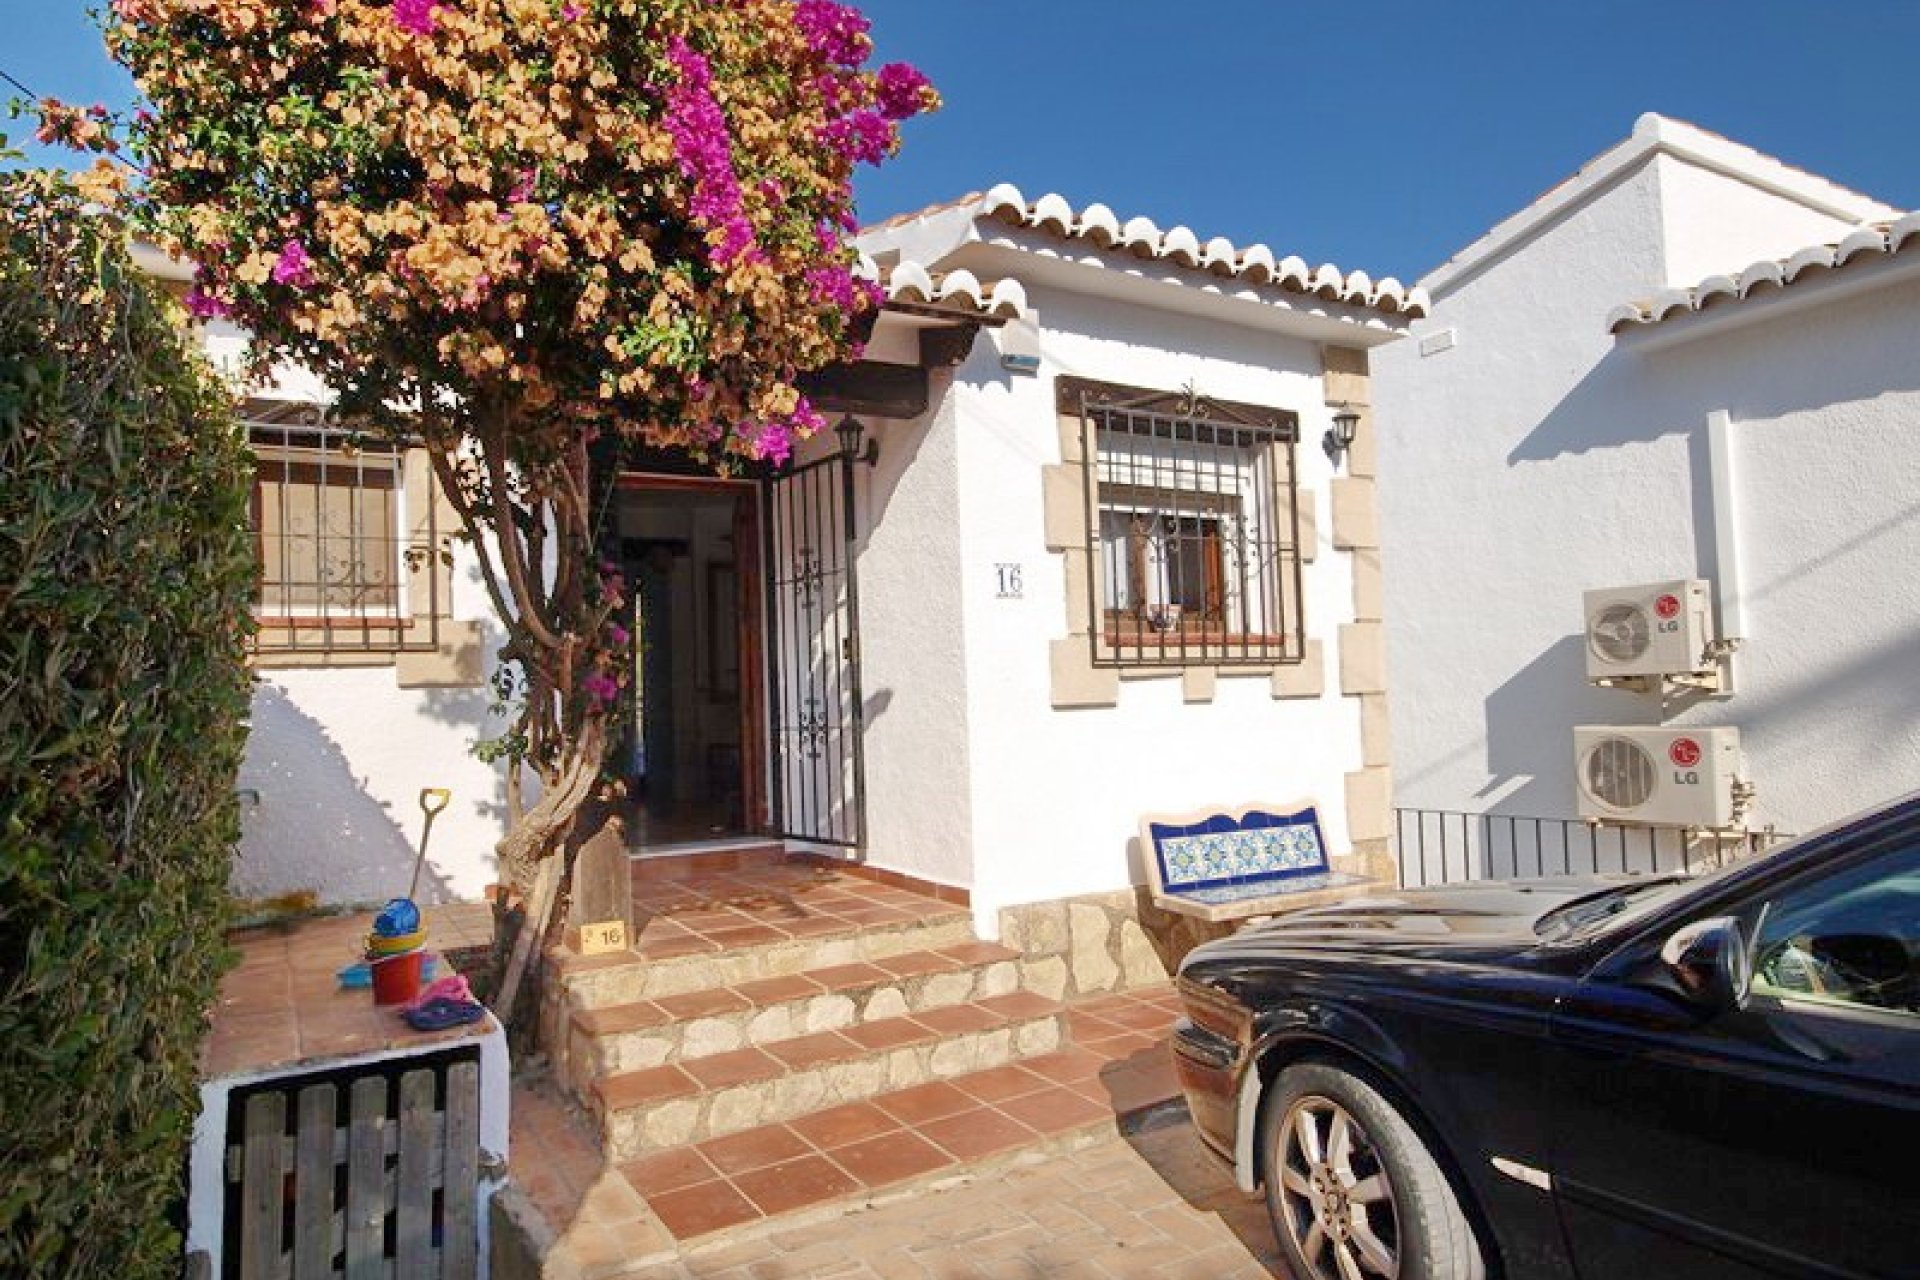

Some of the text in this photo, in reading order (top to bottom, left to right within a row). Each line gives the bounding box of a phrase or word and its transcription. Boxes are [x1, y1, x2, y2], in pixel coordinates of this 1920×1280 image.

[998, 567, 1022, 593] 16
[1658, 621, 1678, 633] LG
[1674, 771, 1698, 785] LG
